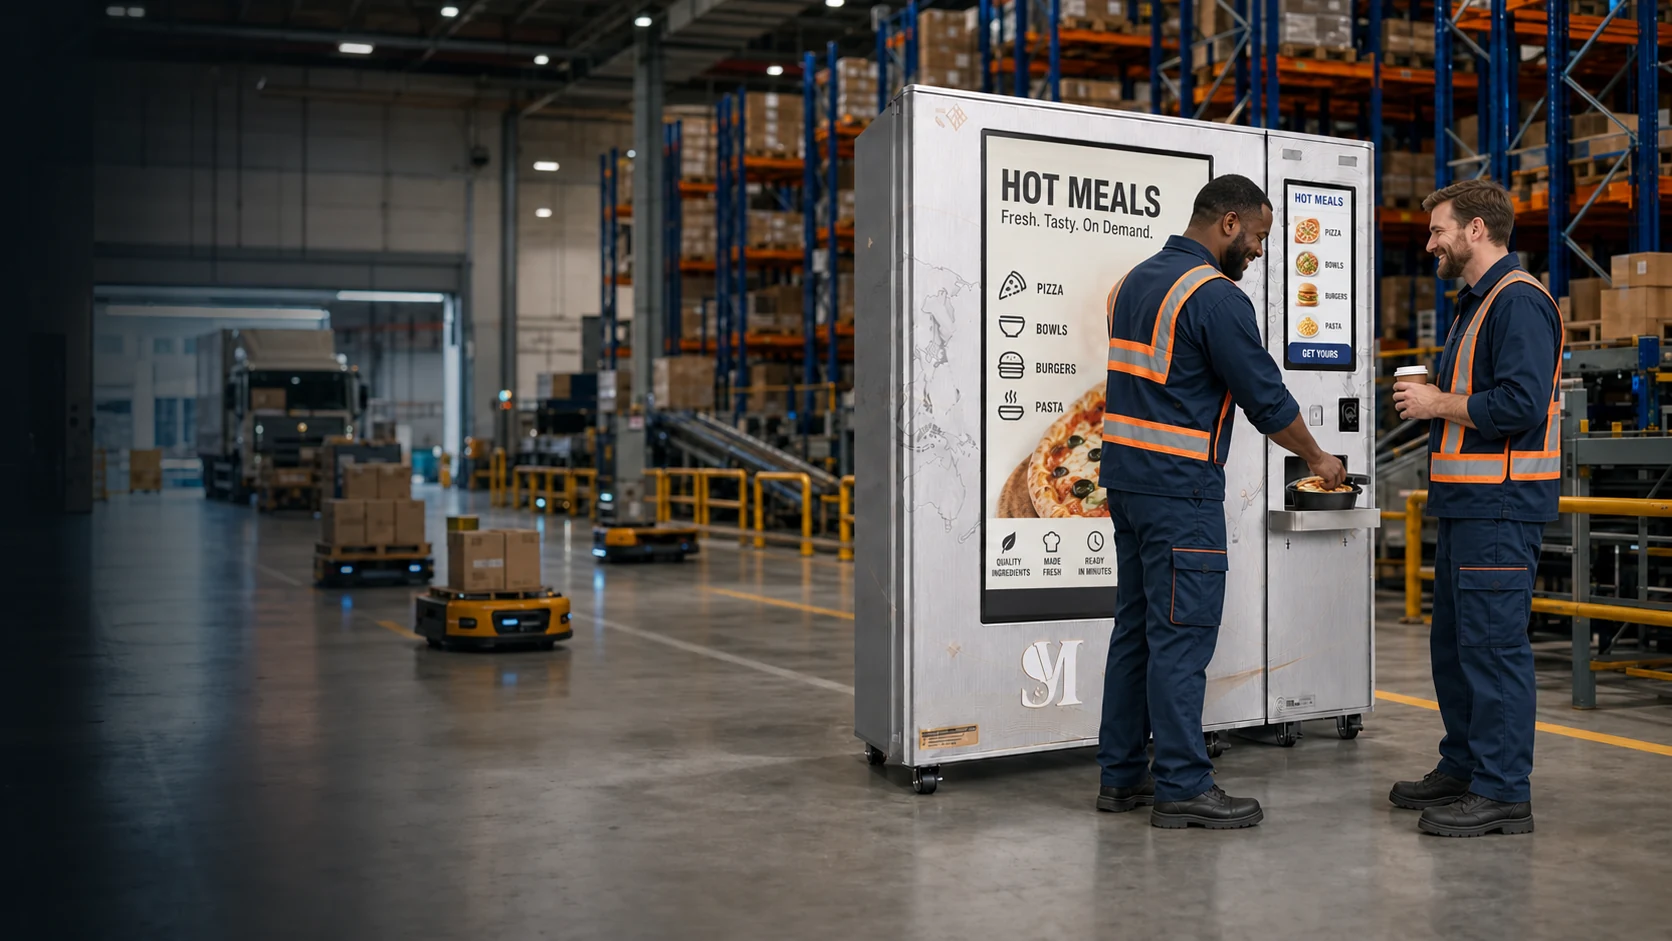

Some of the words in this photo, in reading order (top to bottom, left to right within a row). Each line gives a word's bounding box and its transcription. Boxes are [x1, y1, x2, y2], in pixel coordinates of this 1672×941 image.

[1002, 168, 1060, 206] HOT
[1068, 176, 1161, 218] MEALS
[1294, 192, 1313, 204] HOT
[1314, 194, 1344, 207] MEALS
[1001, 209, 1040, 227] Fresh.
[1044, 213, 1079, 233] Tasty.
[1083, 217, 1099, 233] On
[1103, 220, 1153, 239] Demand.
[1324, 228, 1342, 237] PIZZA
[1324, 261, 1344, 270] BOWLS
[1037, 282, 1064, 296] PIZZA
[1324, 292, 1348, 301] BURGERS
[1036, 323, 1068, 336] BOWLS
[1324, 322, 1342, 330] PASTA
[1302, 349, 1315, 358] GET
[1316, 349, 1339, 359] YOURS
[1035, 362, 1076, 375] BURGERS
[1035, 401, 1064, 413] PASTA
[996, 558, 1022, 566] QUALITY
[1043, 557, 1061, 565] MADE
[1084, 557, 1105, 565] READY
[991, 568, 1031, 577] INGREDIENTS
[1042, 568, 1062, 576] FRESH
[1078, 567, 1085, 575] IN
[1086, 567, 1112, 575] MINUTES
